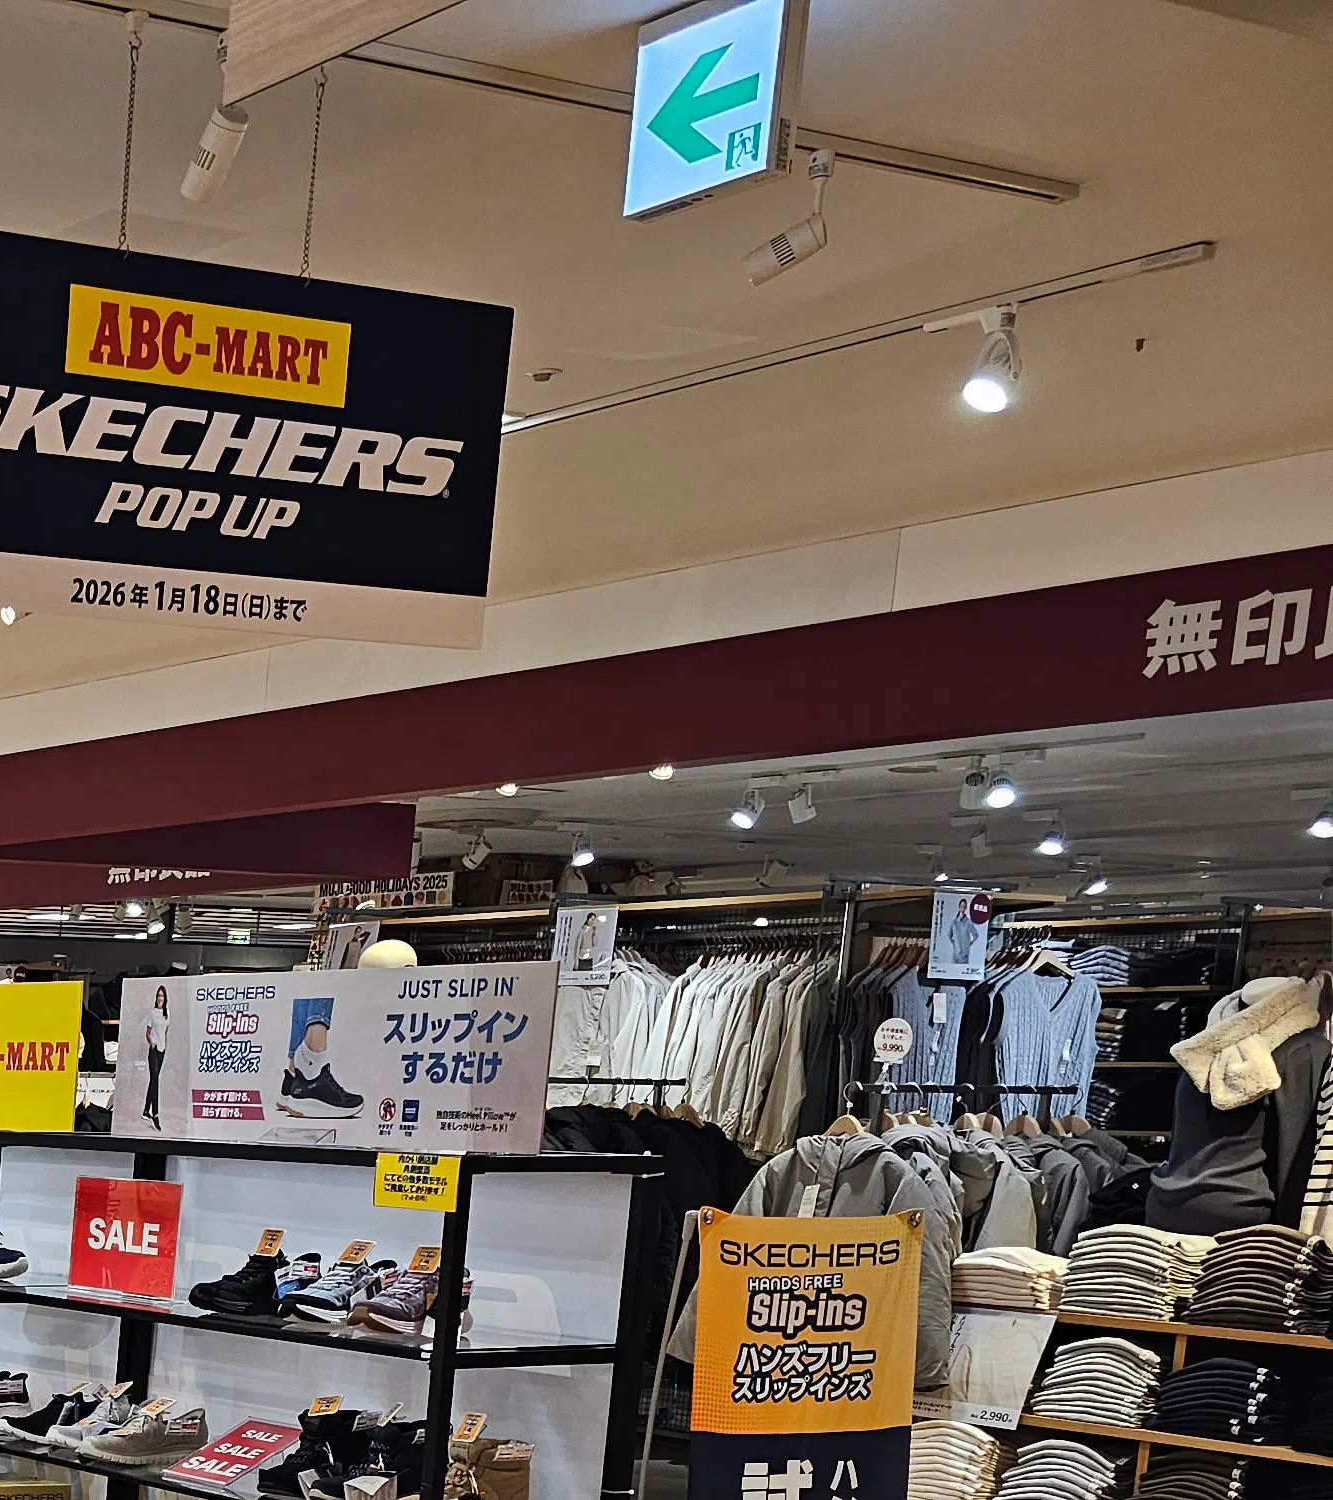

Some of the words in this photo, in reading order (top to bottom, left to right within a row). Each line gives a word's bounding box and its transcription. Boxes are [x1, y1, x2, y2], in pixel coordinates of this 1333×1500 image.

[88, 301, 329, 387] ABC-MART
[95, 481, 222, 533] POP
[220, 496, 301, 540] UP
[1143, 588, 1333, 679] 無印
[346, 880, 371, 895] GOOD
[374, 876, 421, 894] HOLIDAYS
[423, 874, 448, 889] 2025
[197, 986, 275, 1001] SKECHERS
[398, 980, 442, 999] JUST
[448, 978, 488, 997] SLIP
[494, 977, 514, 996] IN
[208, 1013, 258, 1037] Slip-ins
[383, 1010, 529, 1045] スリップイン
[201, 1041, 262, 1057] ハンズフリー
[199, 1057, 260, 1072] スリップインズ
[400, 1052, 502, 1085] するだけ
[88, 1217, 160, 1256] SALE
[719, 1240, 901, 1268] SKECHERS
[748, 1276, 800, 1291] HANDS
[804, 1274, 843, 1289] FREE
[752, 1292, 864, 1334] Slip-ins
[737, 1344, 875, 1373] ハンズフリー
[735, 1371, 871, 1400] スリップインズ
[242, 1430, 283, 1443] SALE
[214, 1443, 265, 1460] SALE
[182, 1457, 249, 1478] SALE
